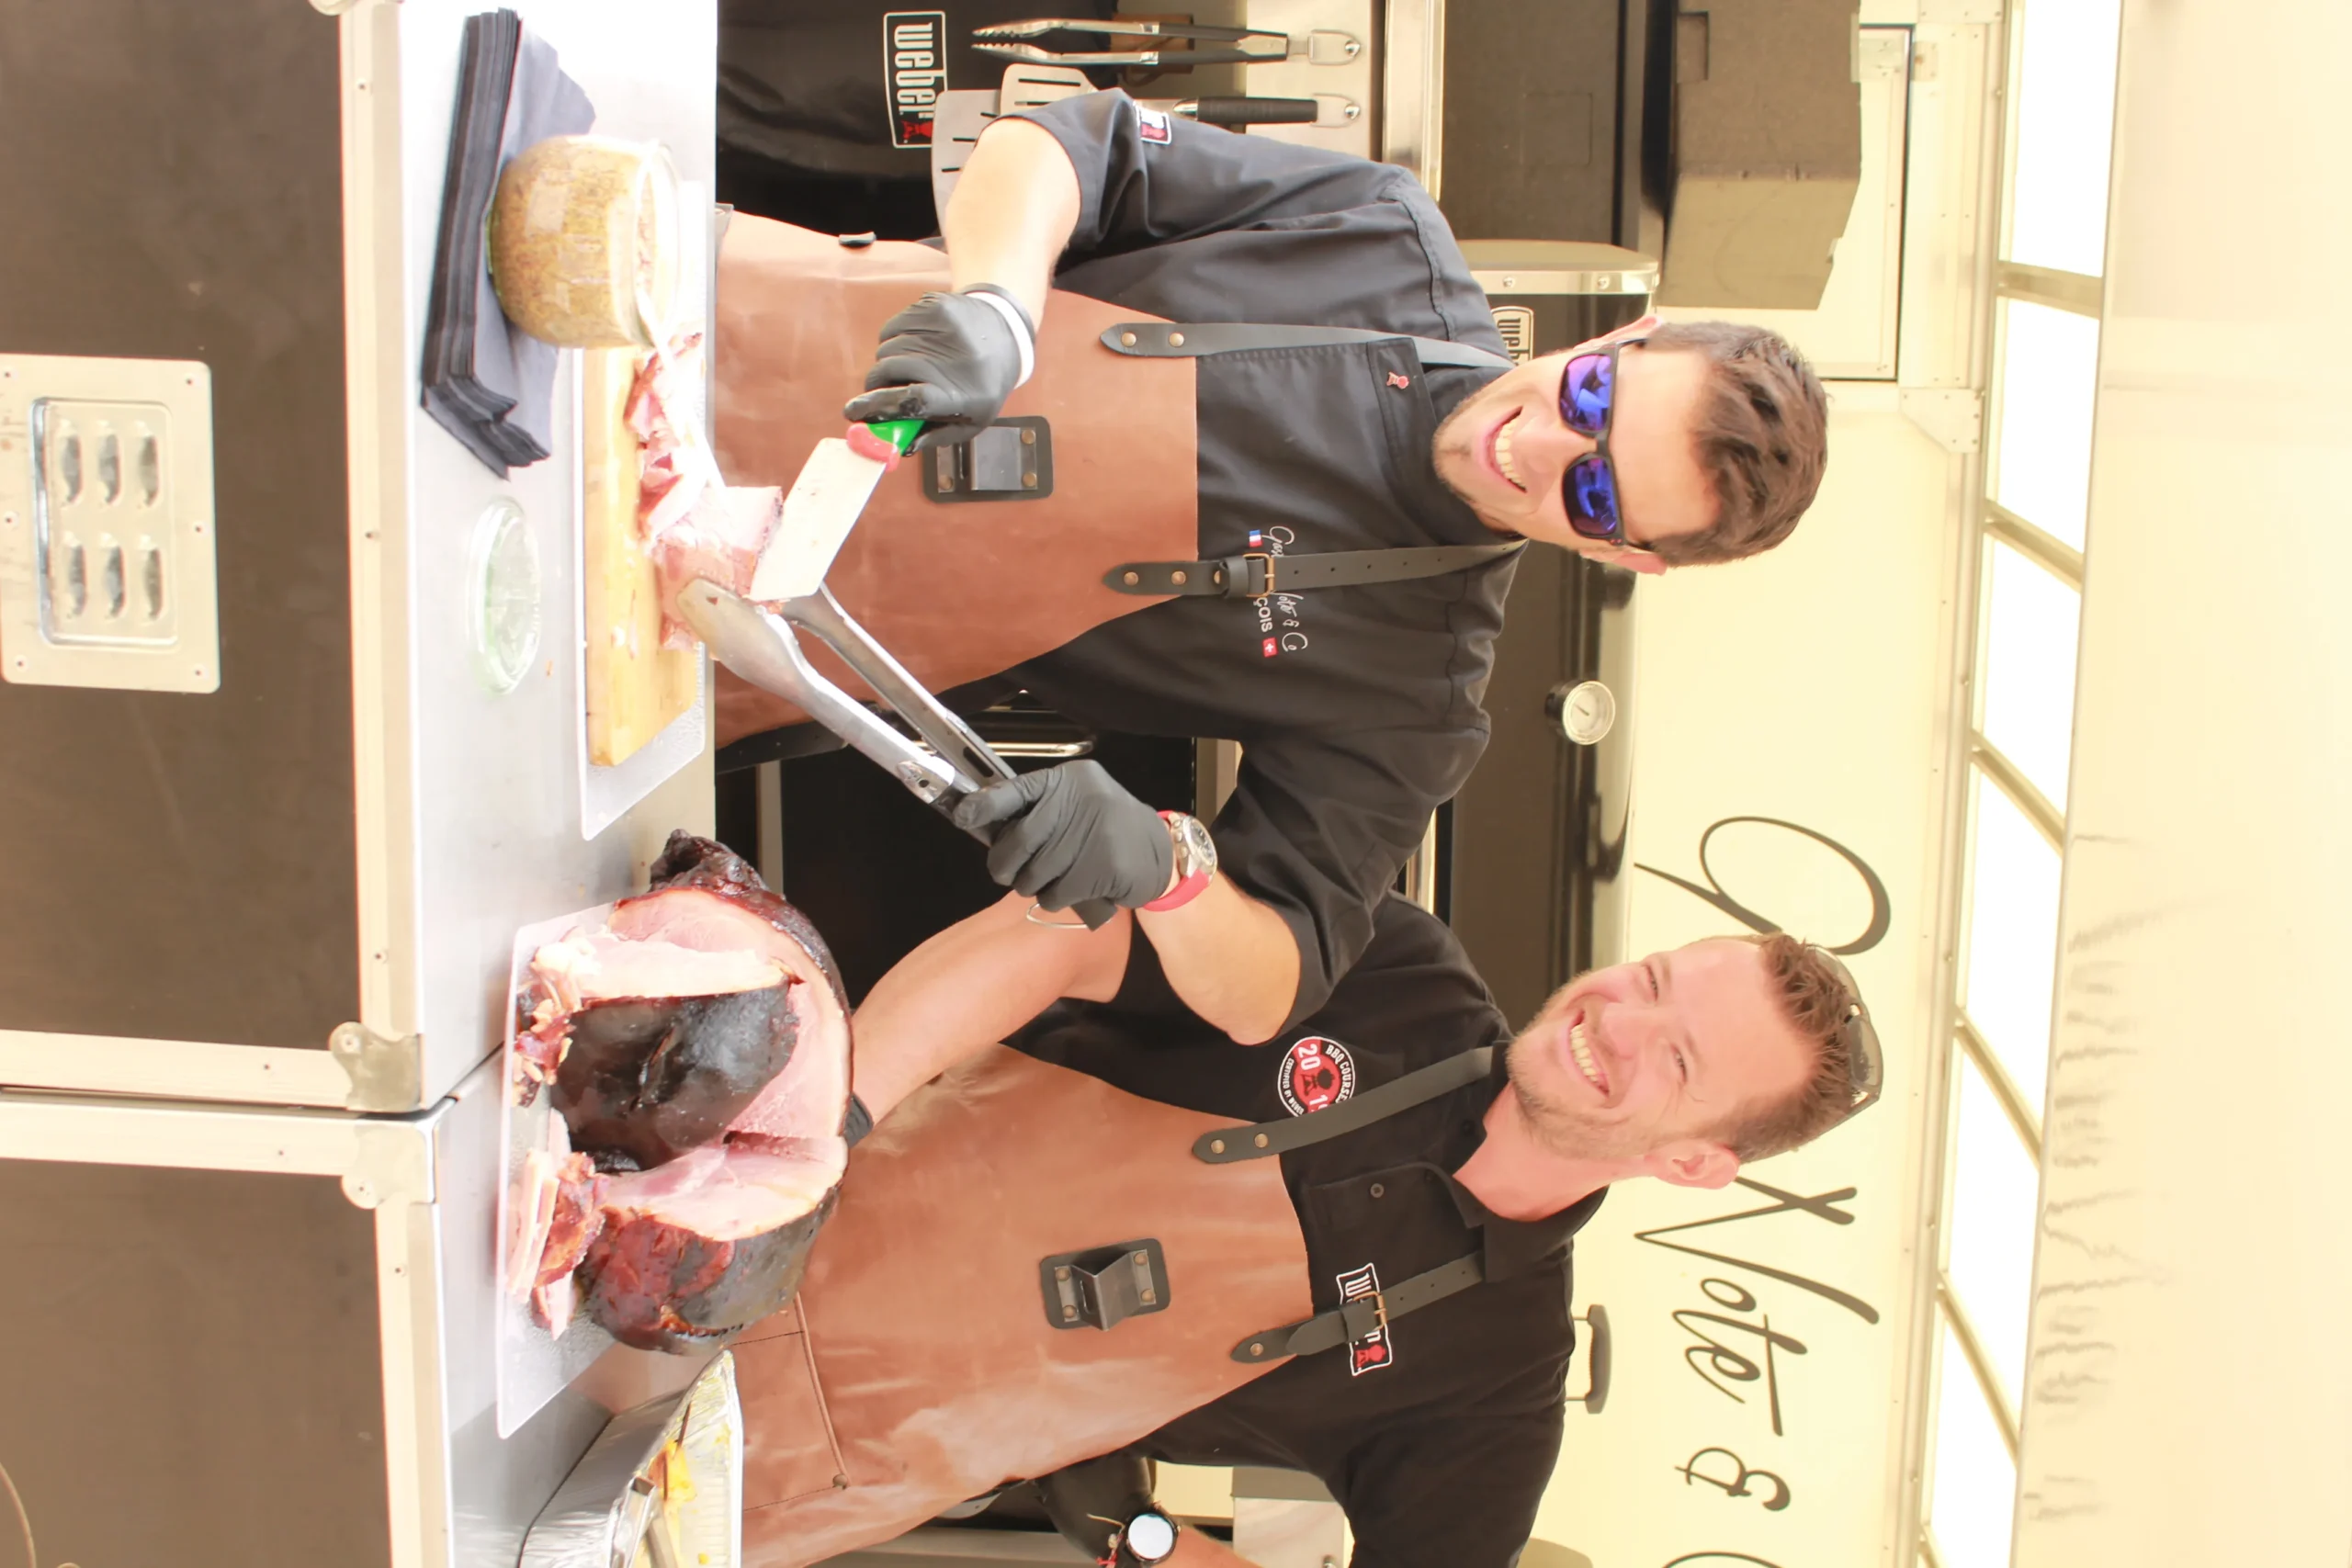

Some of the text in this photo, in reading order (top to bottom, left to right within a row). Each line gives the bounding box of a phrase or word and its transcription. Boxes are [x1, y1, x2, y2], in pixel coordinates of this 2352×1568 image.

[894, 22, 945, 118] weber
[1253, 597, 1272, 632] ÇOIS
[1297, 1043, 1321, 1071] 20
[1326, 1044, 1345, 1065] BBQ
[1283, 1058, 1295, 1089] CERTIFIED
[1634, 1173, 1880, 1437] Note
